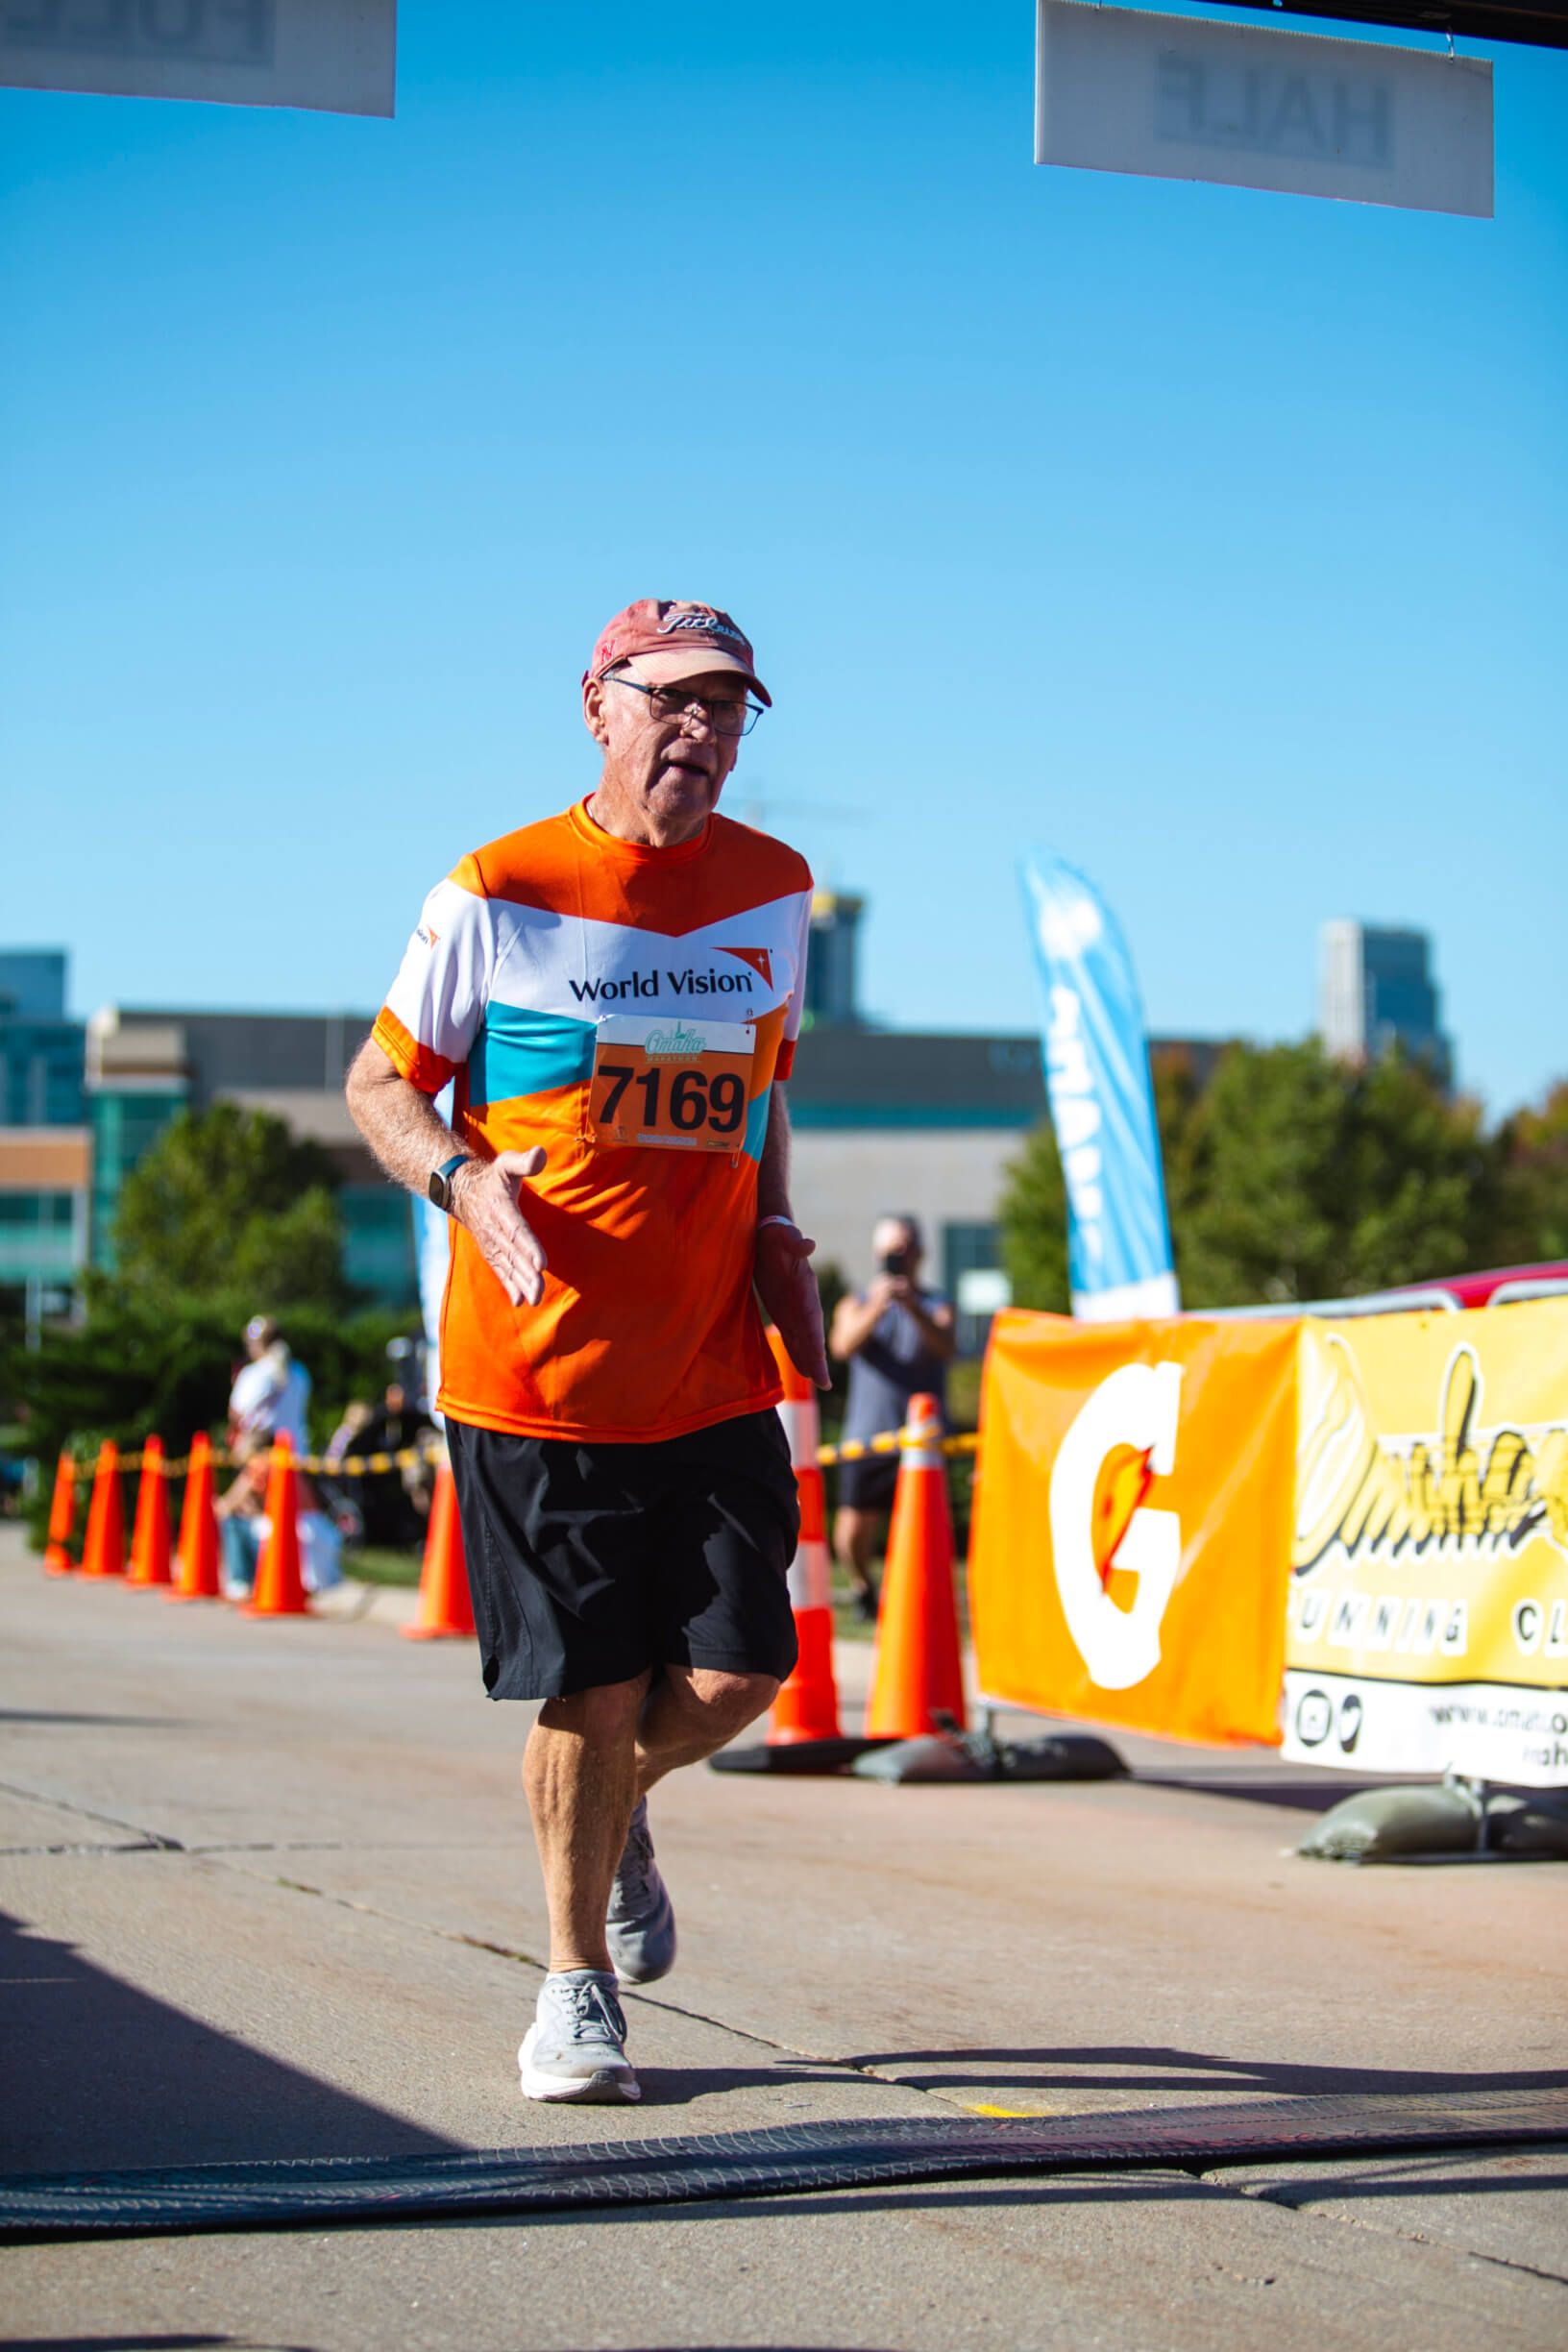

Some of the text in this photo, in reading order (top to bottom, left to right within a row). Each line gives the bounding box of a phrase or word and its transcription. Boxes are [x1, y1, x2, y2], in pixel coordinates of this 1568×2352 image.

[600, 638, 618, 665] N
[569, 968, 752, 1002] World Vision
[645, 1029, 708, 1054] Omaha
[597, 1065, 746, 1134] 7169
[1049, 1360, 1184, 1690] G
[1298, 1594, 1466, 1647] UNNING
